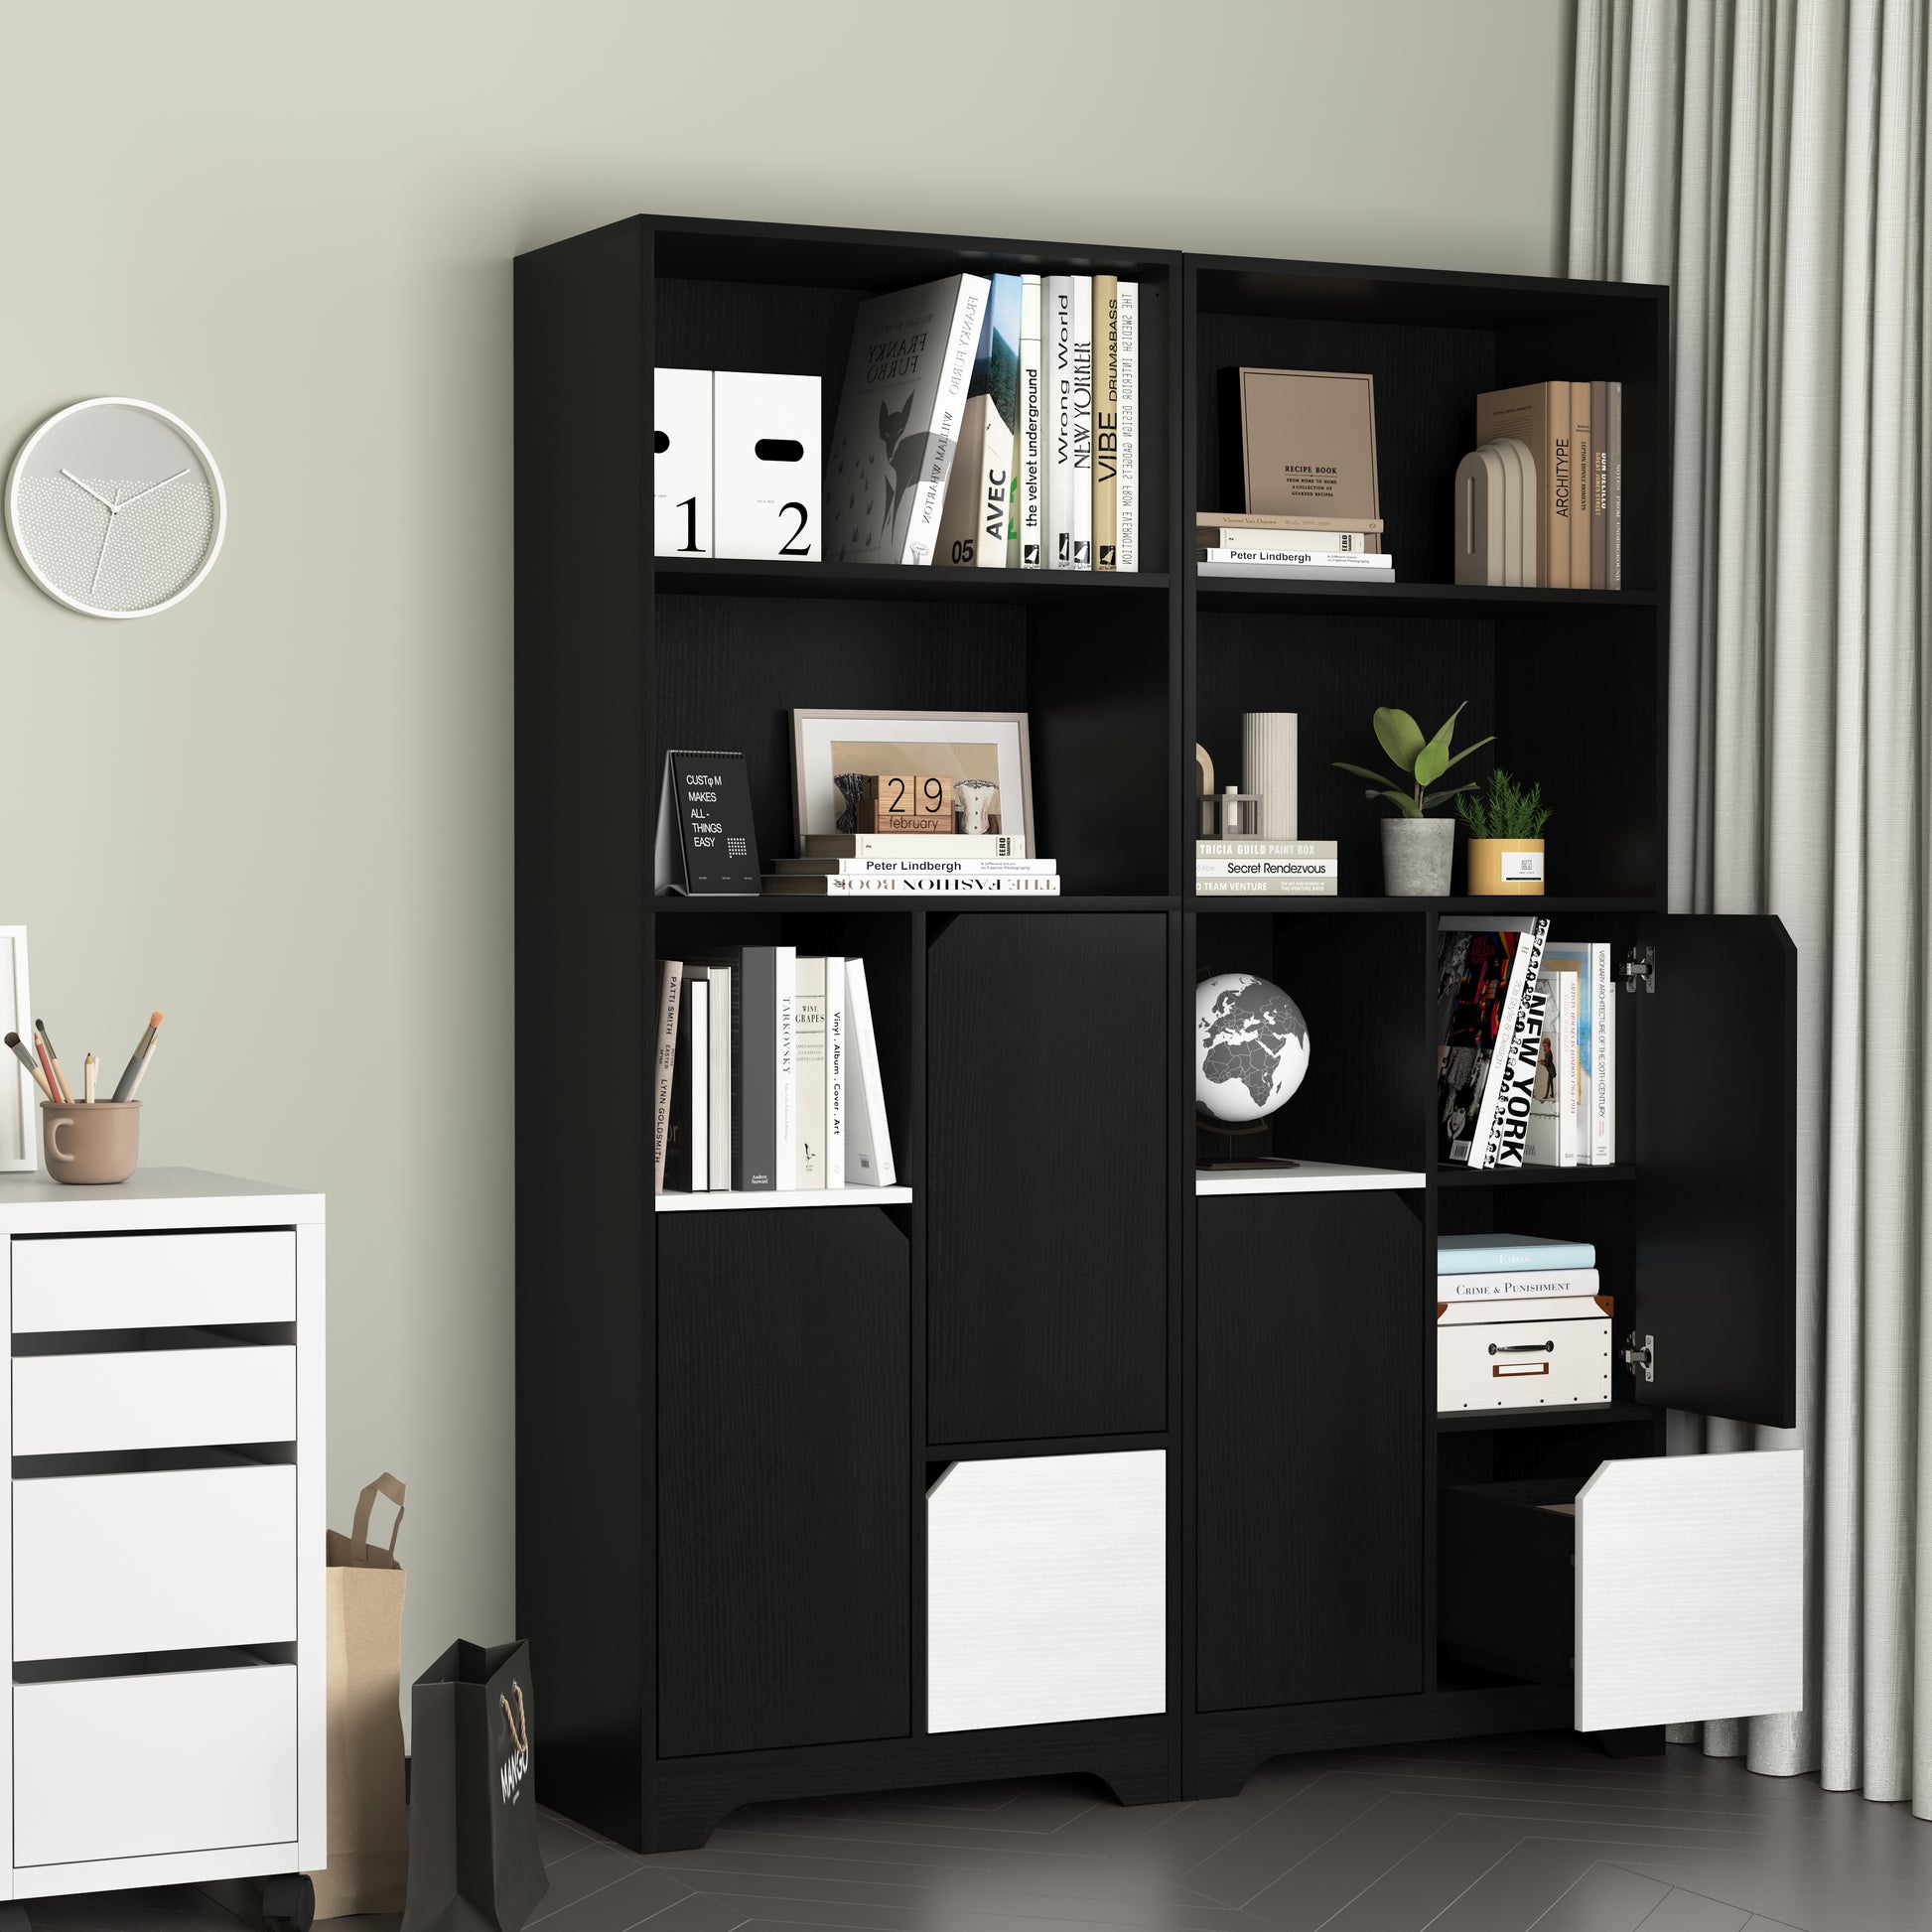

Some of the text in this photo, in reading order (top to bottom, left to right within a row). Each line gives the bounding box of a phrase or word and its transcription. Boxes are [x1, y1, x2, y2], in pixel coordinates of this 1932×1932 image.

[1058, 295, 1070, 465] Wrong World
[1098, 299, 1118, 483] VIBE DRUM&BASS
[1073, 342, 1091, 469] NEW YORKER
[1026, 368, 1039, 527] the velvet underground
[1285, 465, 1312, 474] RECIPE
[1556, 439, 1569, 518] ARCHITYPE
[986, 469, 1007, 540] AVEC
[676, 495, 706, 553] 1
[778, 501, 812, 556] 2
[951, 539, 974, 564] 05
[1230, 550, 1311, 564] Peter Lindbergh
[688, 791, 717, 802] MAKES
[888, 777, 942, 812] 2 9
[691, 808, 706, 819] ALL
[890, 817, 939, 832] february
[692, 822, 723, 834] THINGS
[694, 837, 716, 848] EASY
[1199, 844, 1315, 856] TRICIA GUILD PAINT BOX
[866, 861, 962, 873] Peter Lindbergh
[1227, 862, 1326, 874] Secret Rendezvous
[902, 879, 1001, 891] FASHION
[1203, 882, 1228, 892] TEAM
[1229, 882, 1268, 892] VENTURE
[665, 976, 677, 1035] PATTI SMITH
[795, 1014, 825, 1023] GRAPES
[782, 996, 791, 1073] TARKOVSKY
[1500, 995, 1548, 1168] NEW YORK
[654, 1078, 668, 1164] LYNN GOLDSMITH
